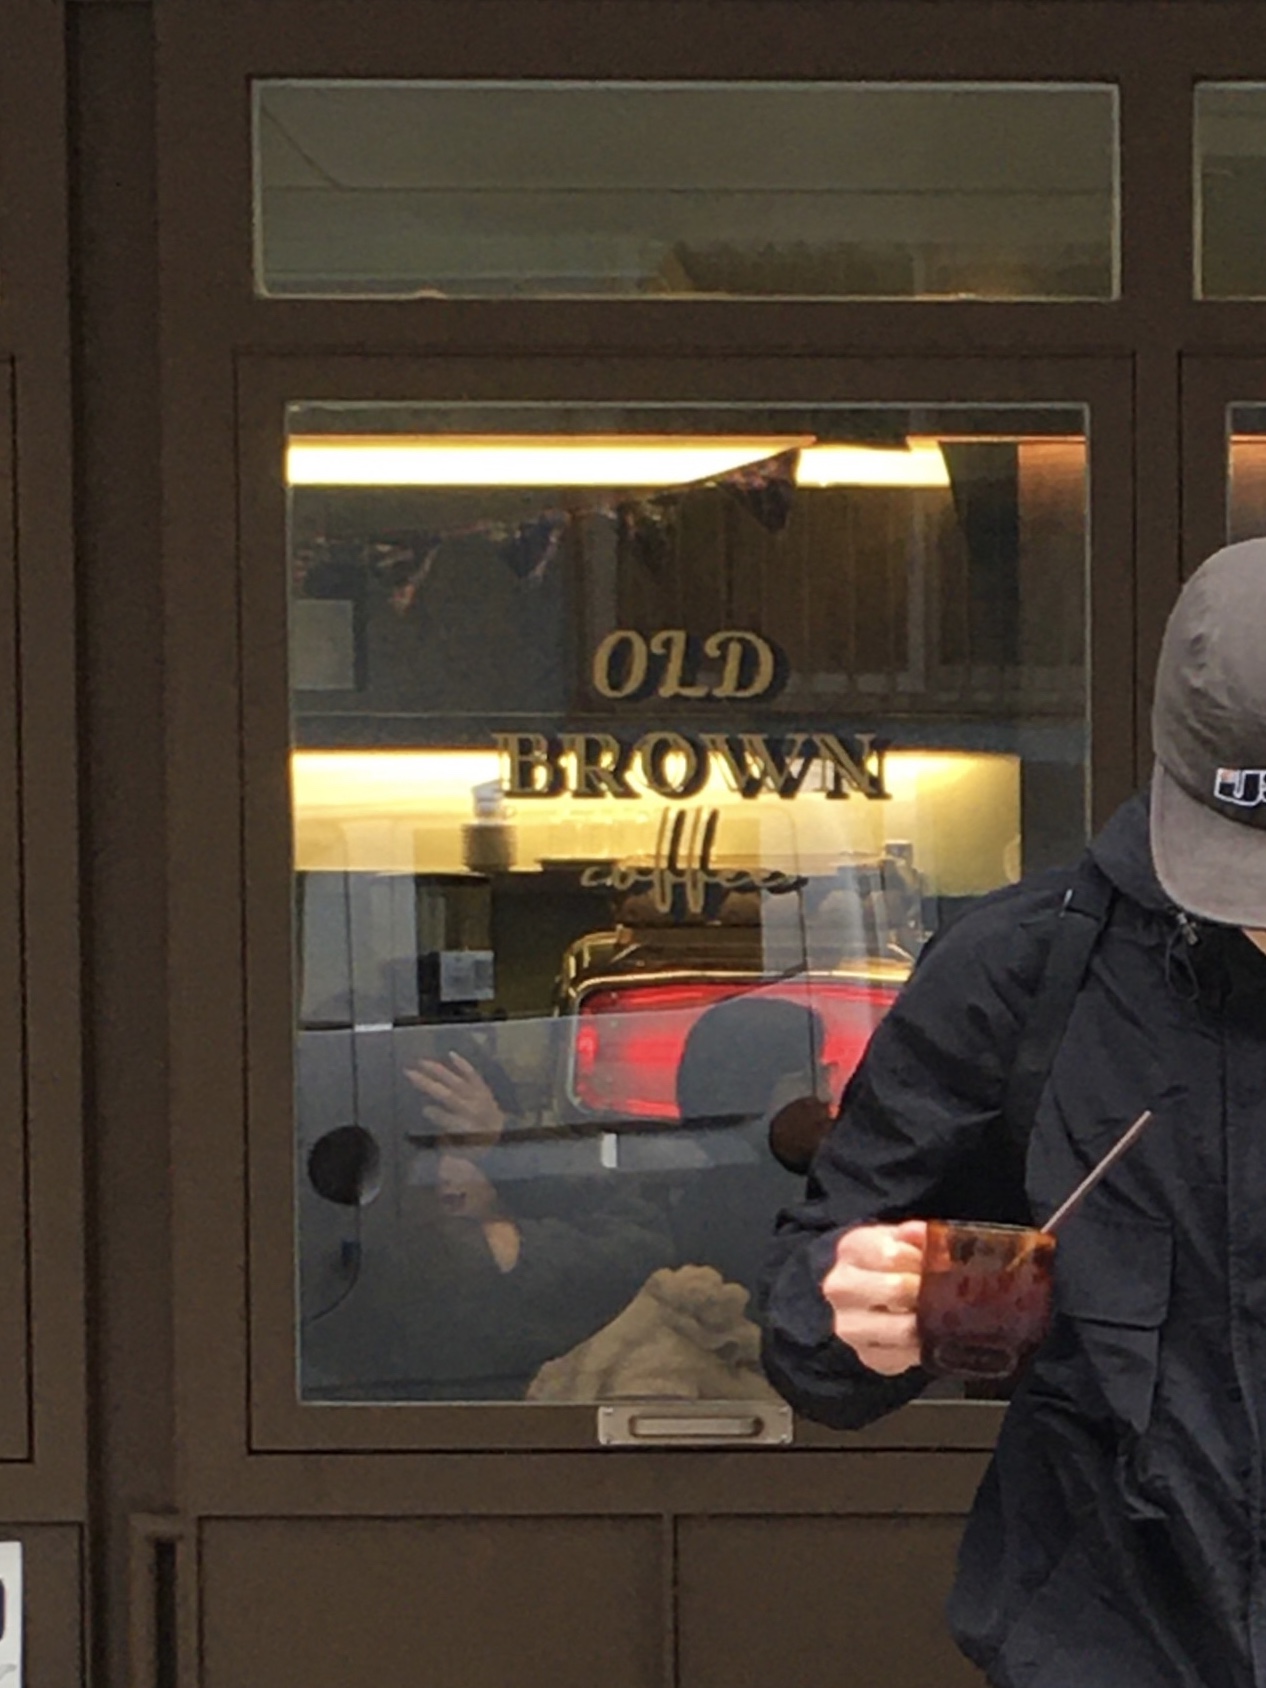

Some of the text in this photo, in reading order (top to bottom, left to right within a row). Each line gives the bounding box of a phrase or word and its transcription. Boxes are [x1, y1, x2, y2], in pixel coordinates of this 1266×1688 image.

[594, 629, 783, 701] OLD
[492, 731, 888, 799] BROWN
[580, 807, 804, 915] coffee
